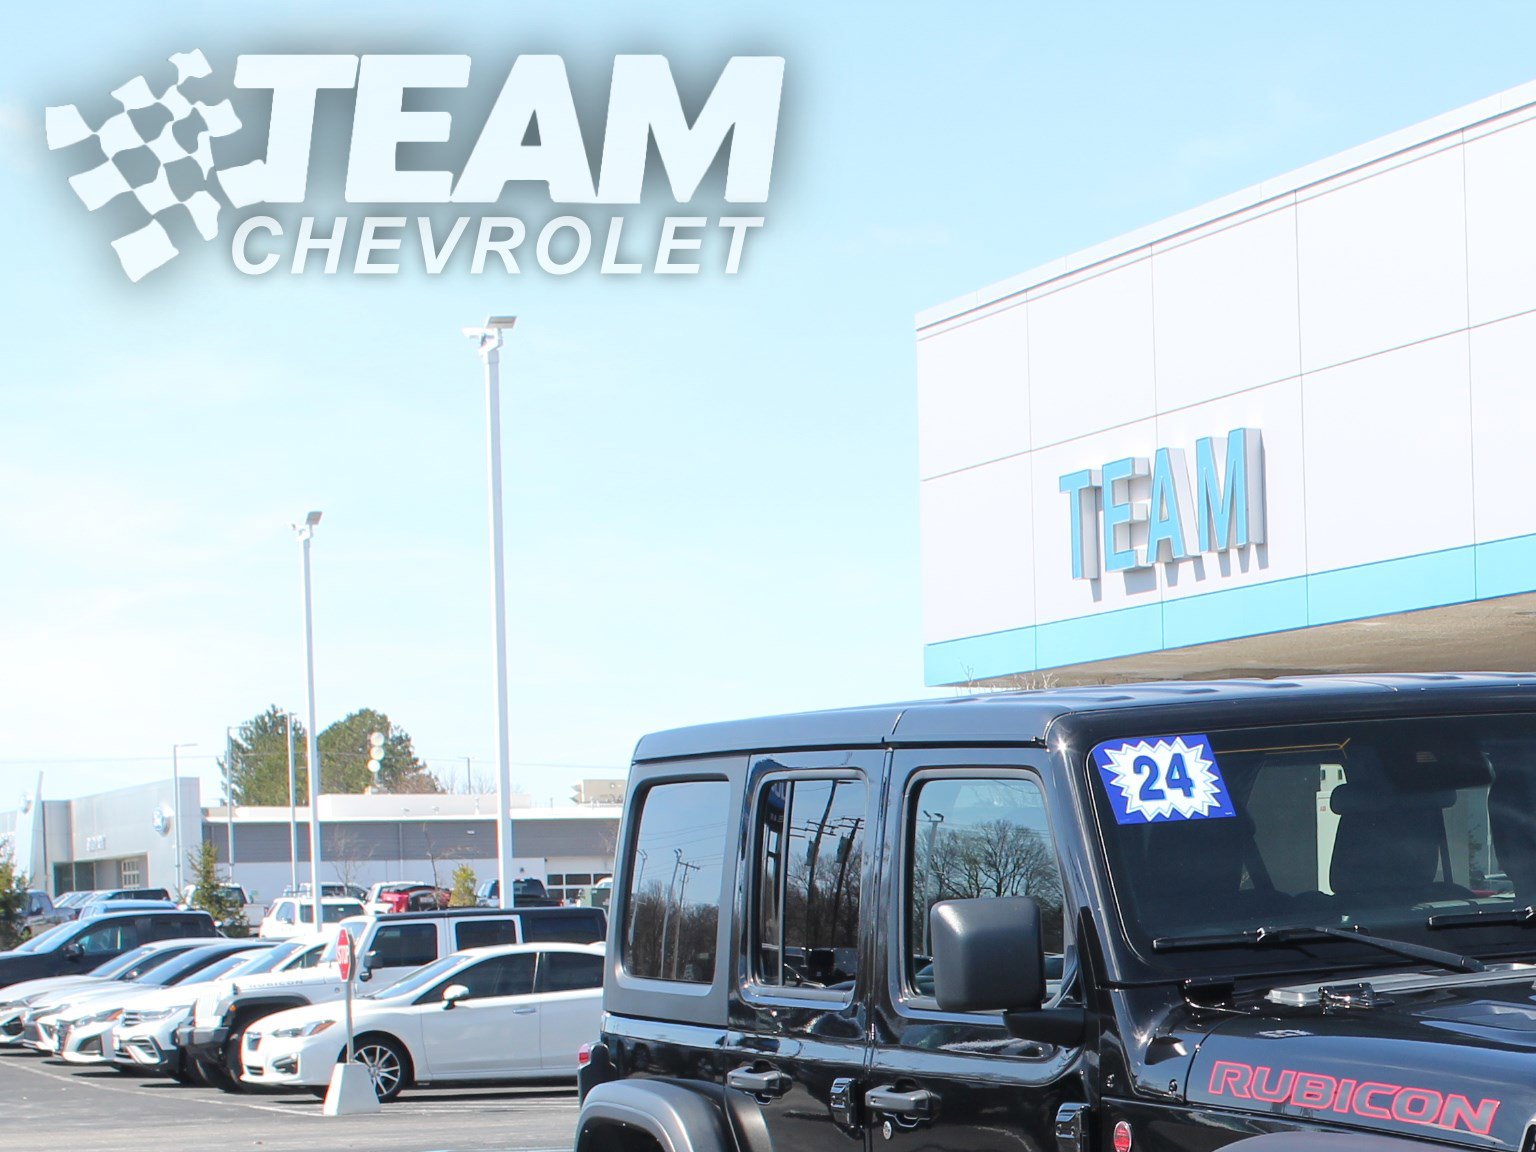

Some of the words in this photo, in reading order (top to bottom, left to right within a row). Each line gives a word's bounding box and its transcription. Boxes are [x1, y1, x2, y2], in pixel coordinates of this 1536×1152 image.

[1059, 428, 1266, 580] TEAM
[1132, 752, 1195, 801] 24
[336, 945, 350, 964] STOP
[1208, 1060, 1501, 1135] RUBICON
